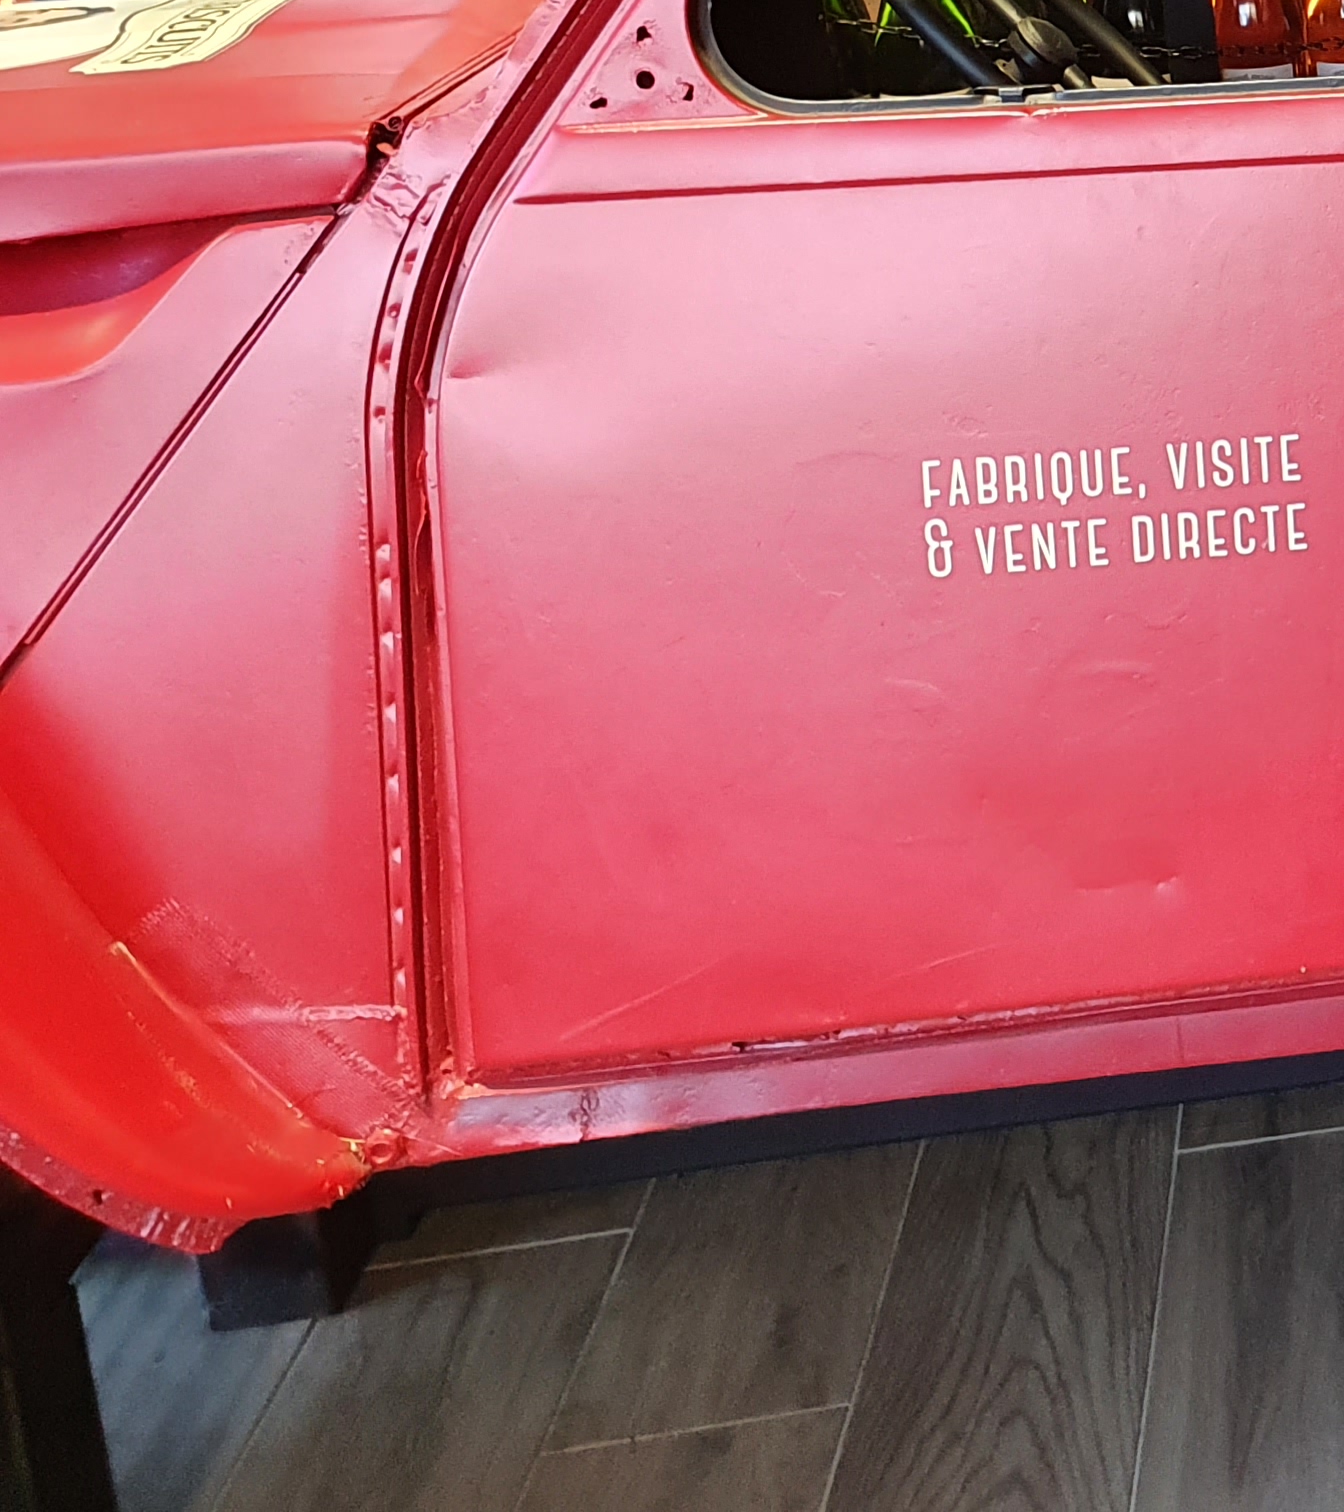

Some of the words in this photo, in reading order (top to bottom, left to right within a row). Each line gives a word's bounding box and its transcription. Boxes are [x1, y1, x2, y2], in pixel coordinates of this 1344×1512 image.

[921, 446, 1148, 509] FABRIQUE,
[1165, 433, 1302, 491] VISITE
[924, 517, 954, 580] &
[974, 518, 1110, 576] VENTE
[1131, 502, 1309, 564] DIRECTE
